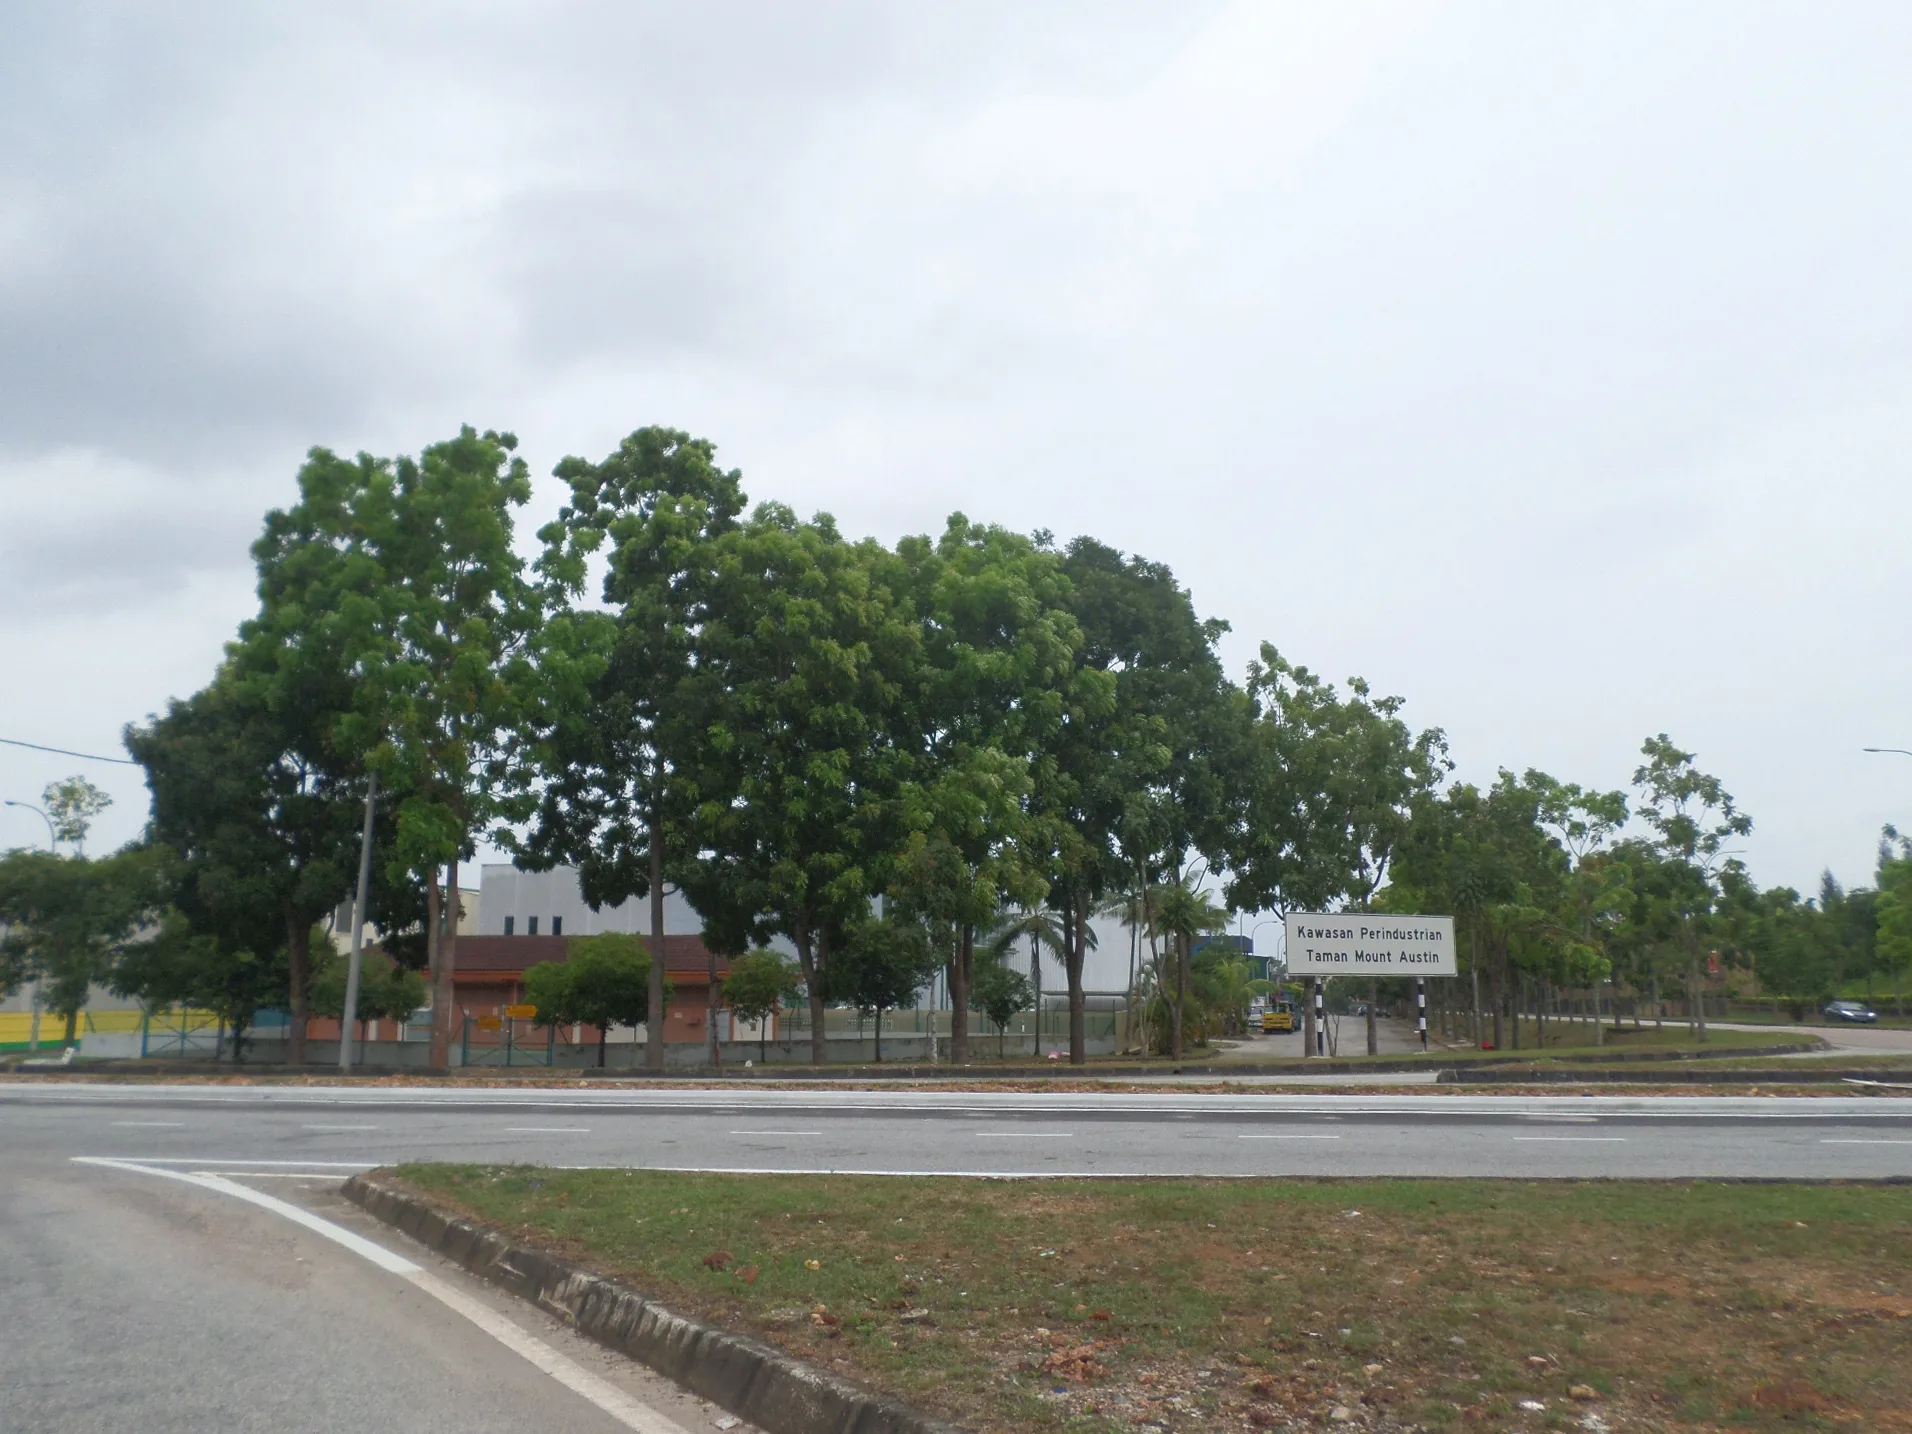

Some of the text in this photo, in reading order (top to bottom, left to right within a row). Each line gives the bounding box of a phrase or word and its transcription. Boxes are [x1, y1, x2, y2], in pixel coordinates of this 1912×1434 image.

[1297, 926, 1442, 941] Kawasan Perindustrian
[1306, 950, 1439, 963] Taman Mount Austin
